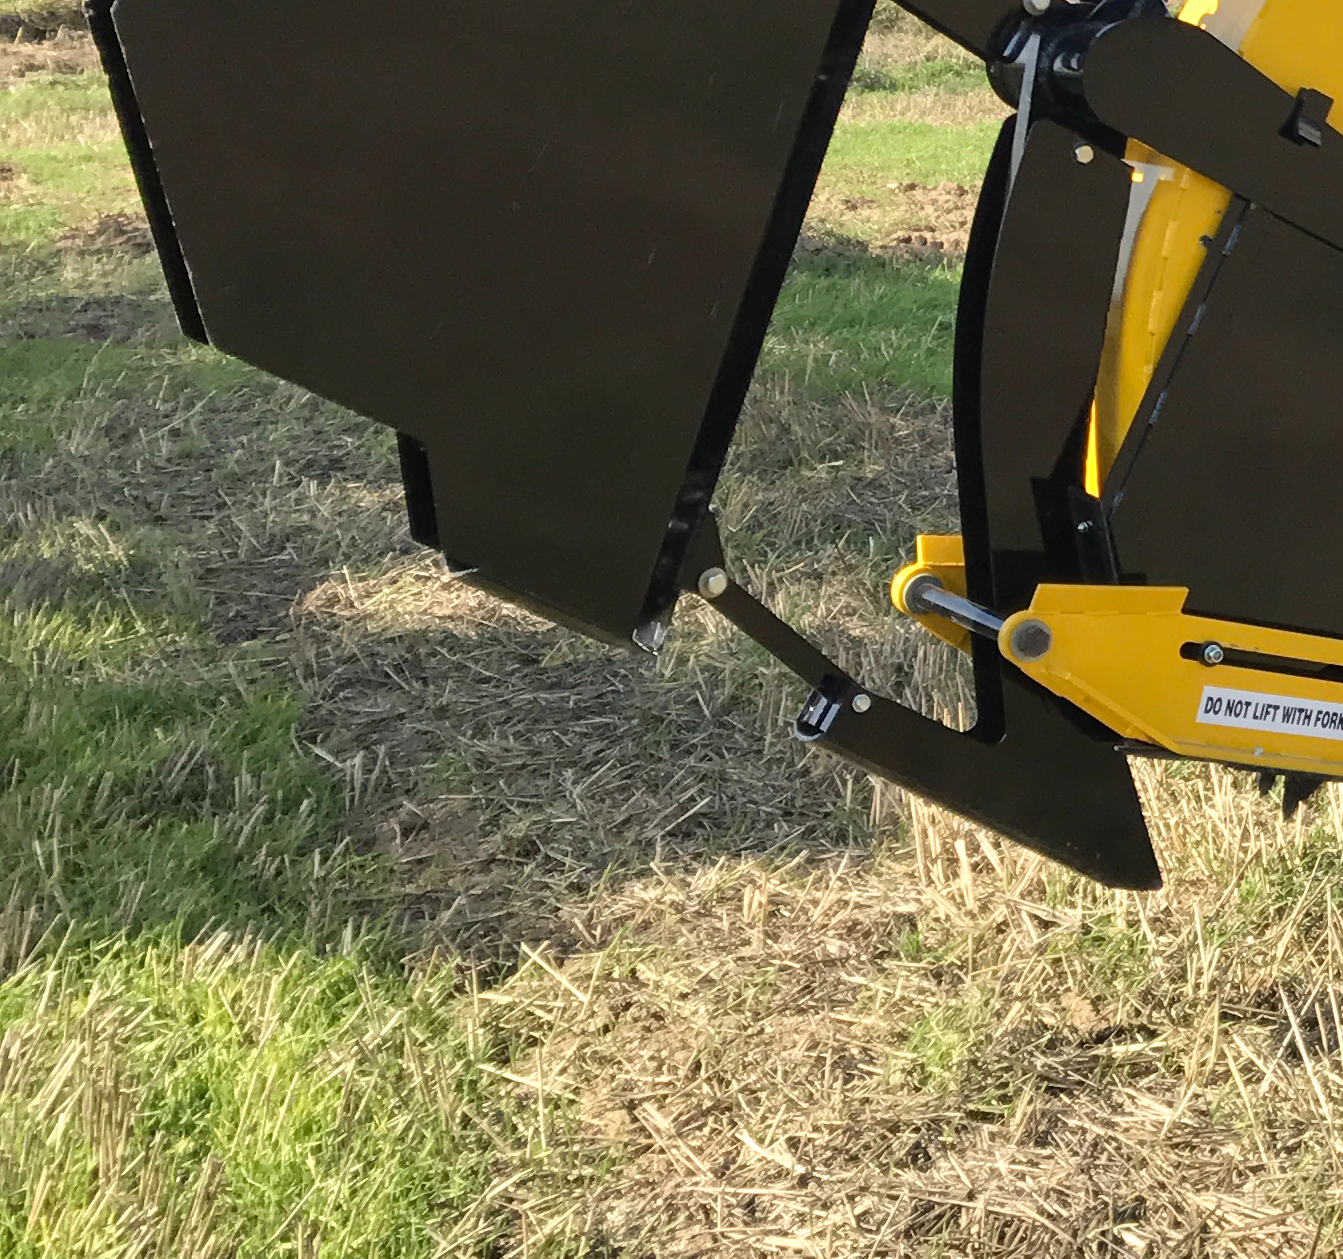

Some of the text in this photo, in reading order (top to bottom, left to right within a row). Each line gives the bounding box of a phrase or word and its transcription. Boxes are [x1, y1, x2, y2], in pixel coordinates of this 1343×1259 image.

[1203, 696, 1222, 716] DO
[1224, 699, 1252, 718] NOT
[1253, 702, 1280, 722] LIFT
[1281, 705, 1313, 726] WITH
